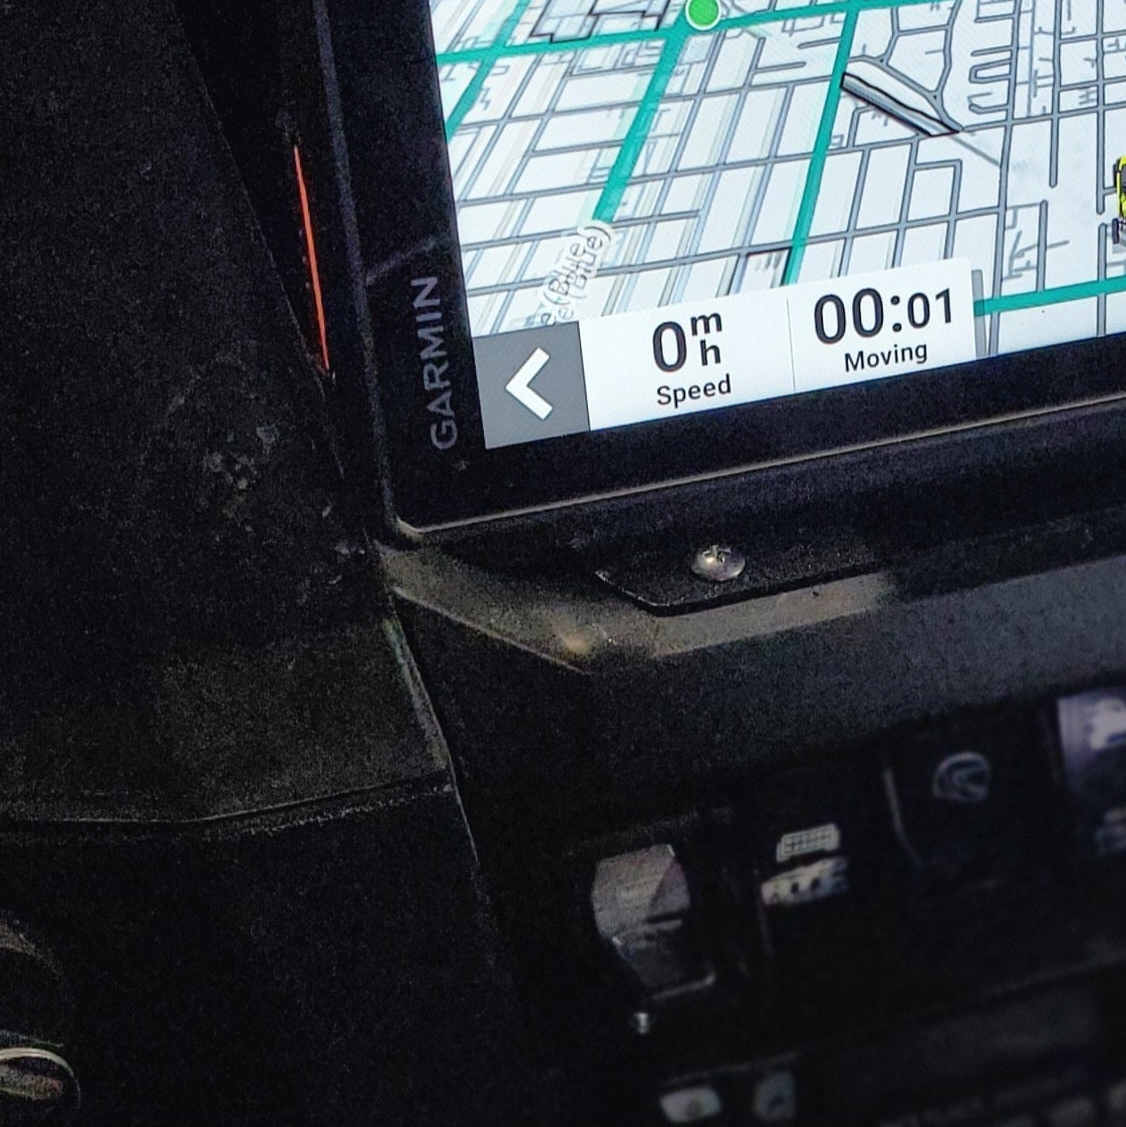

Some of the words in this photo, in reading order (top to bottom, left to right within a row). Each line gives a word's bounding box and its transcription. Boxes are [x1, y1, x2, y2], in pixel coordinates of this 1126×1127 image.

[813, 287, 952, 345] 00:01
[410, 276, 458, 450] GARMIN
[652, 321, 688, 372] 0
[844, 343, 928, 373] Moving
[656, 374, 731, 408] Speed
